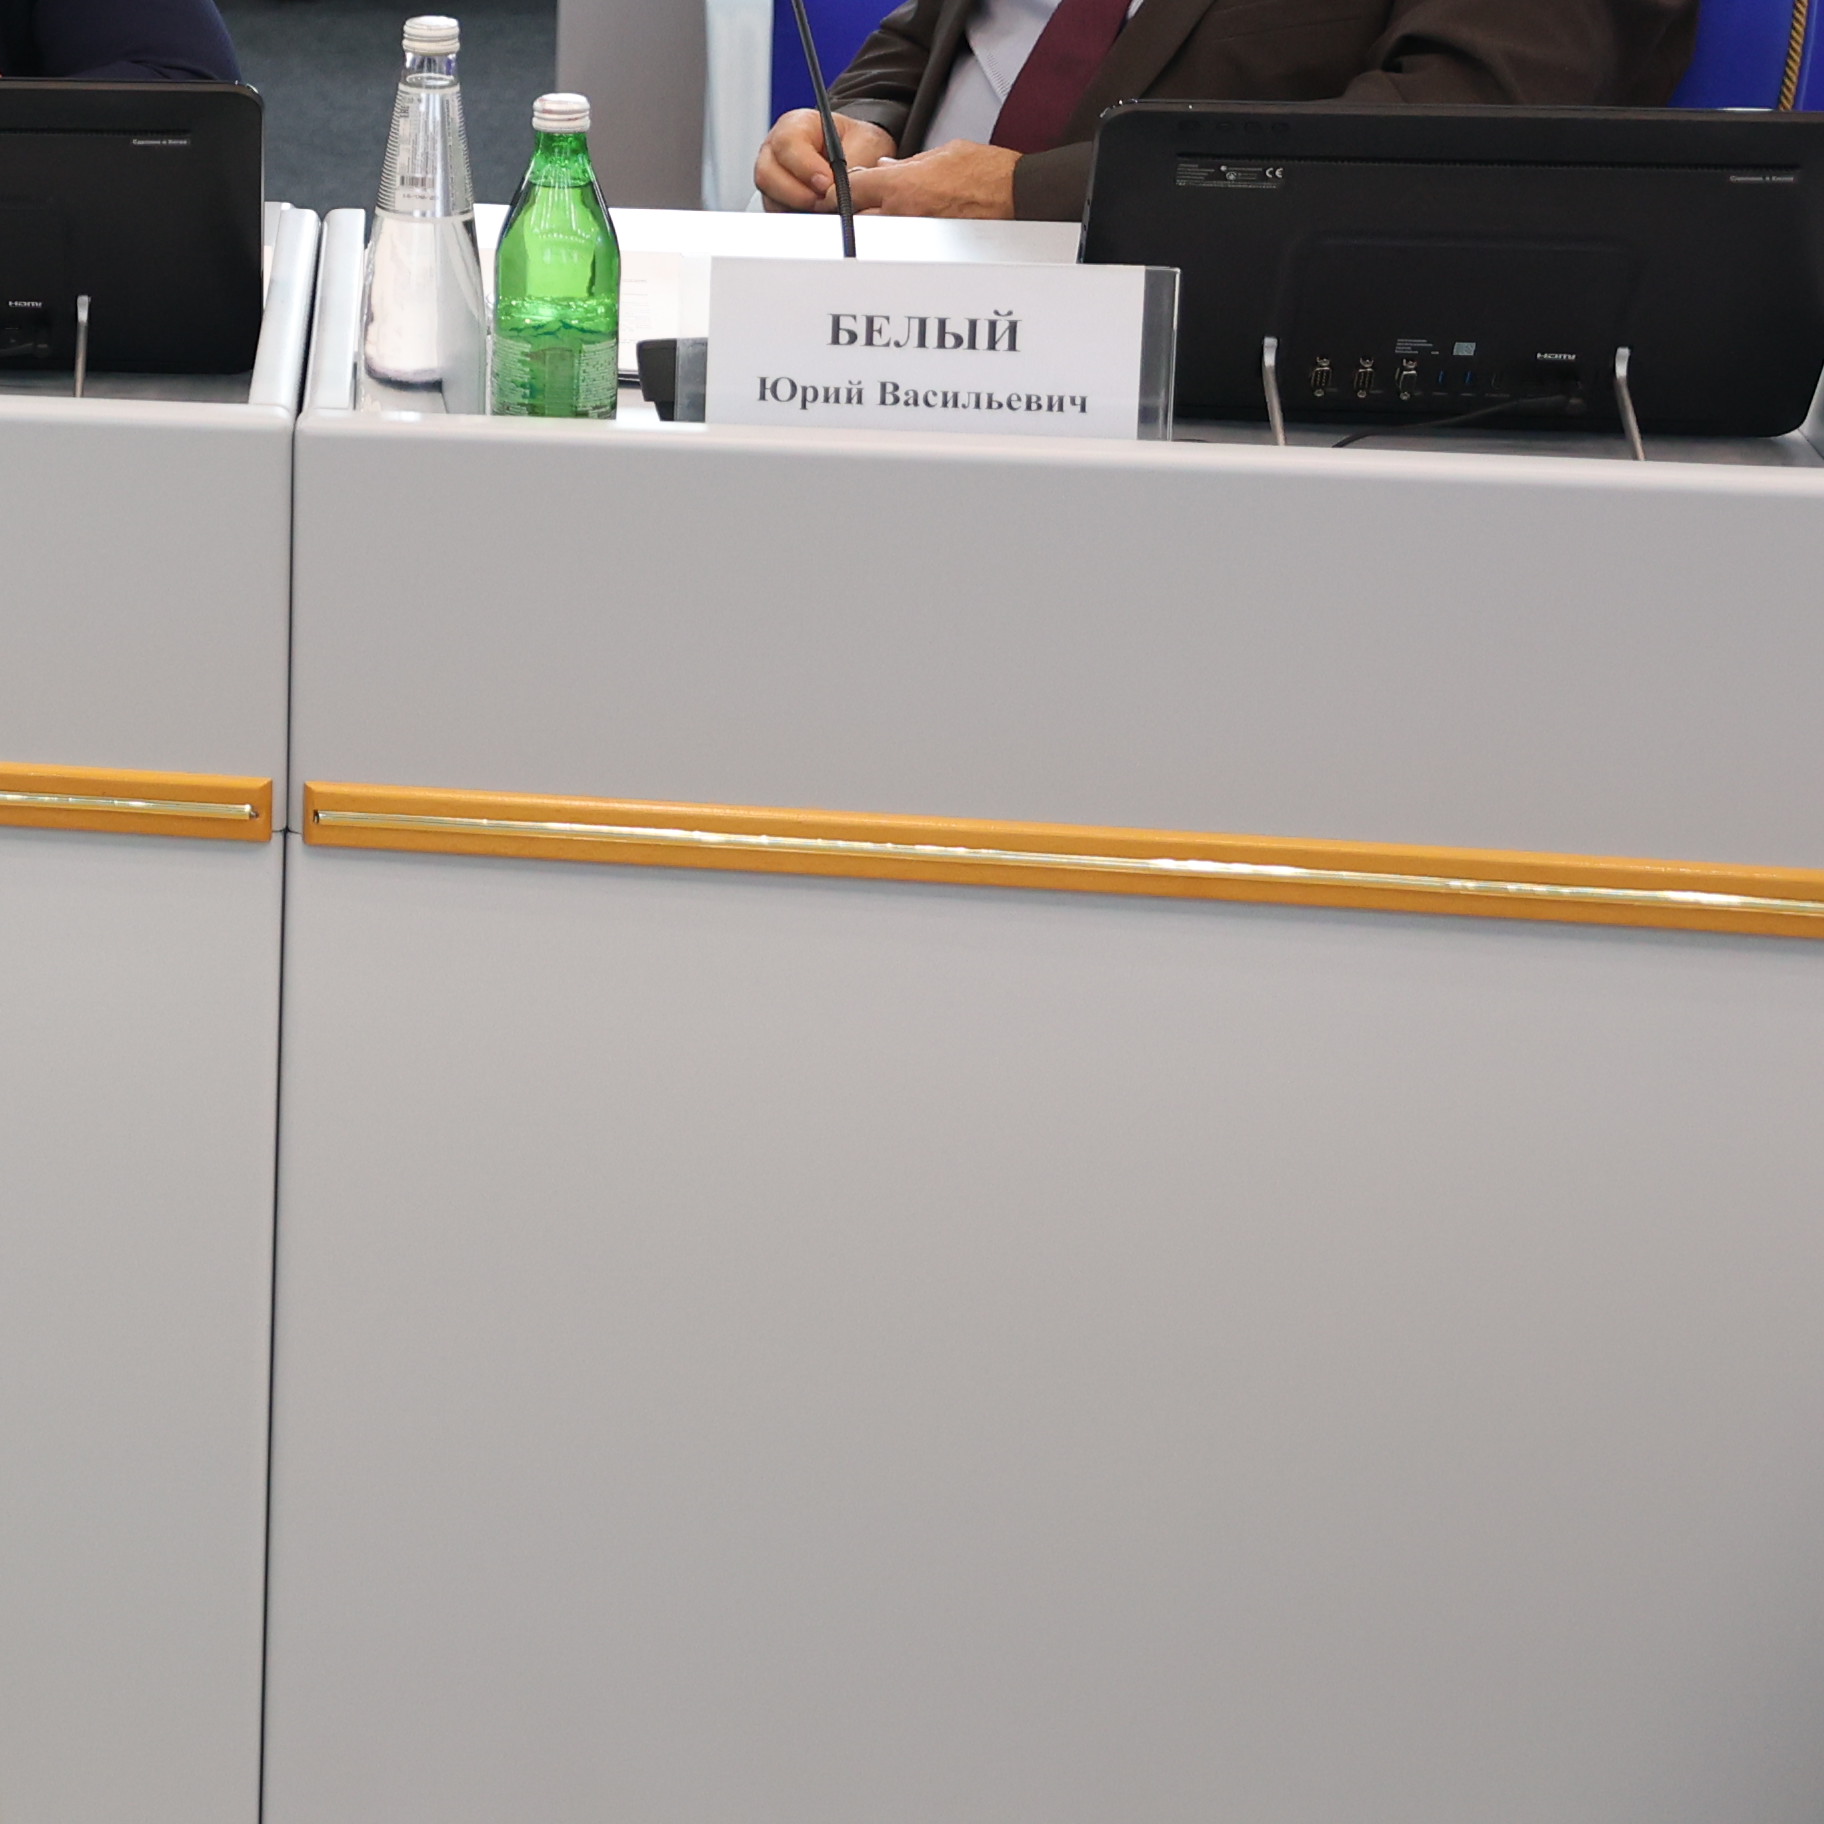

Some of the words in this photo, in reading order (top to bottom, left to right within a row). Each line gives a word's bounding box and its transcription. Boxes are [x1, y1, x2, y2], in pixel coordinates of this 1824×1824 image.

[826, 309, 1023, 353] БЕЛЫЙ
[757, 375, 864, 410] Юрий
[877, 380, 1088, 414] Васильевич
